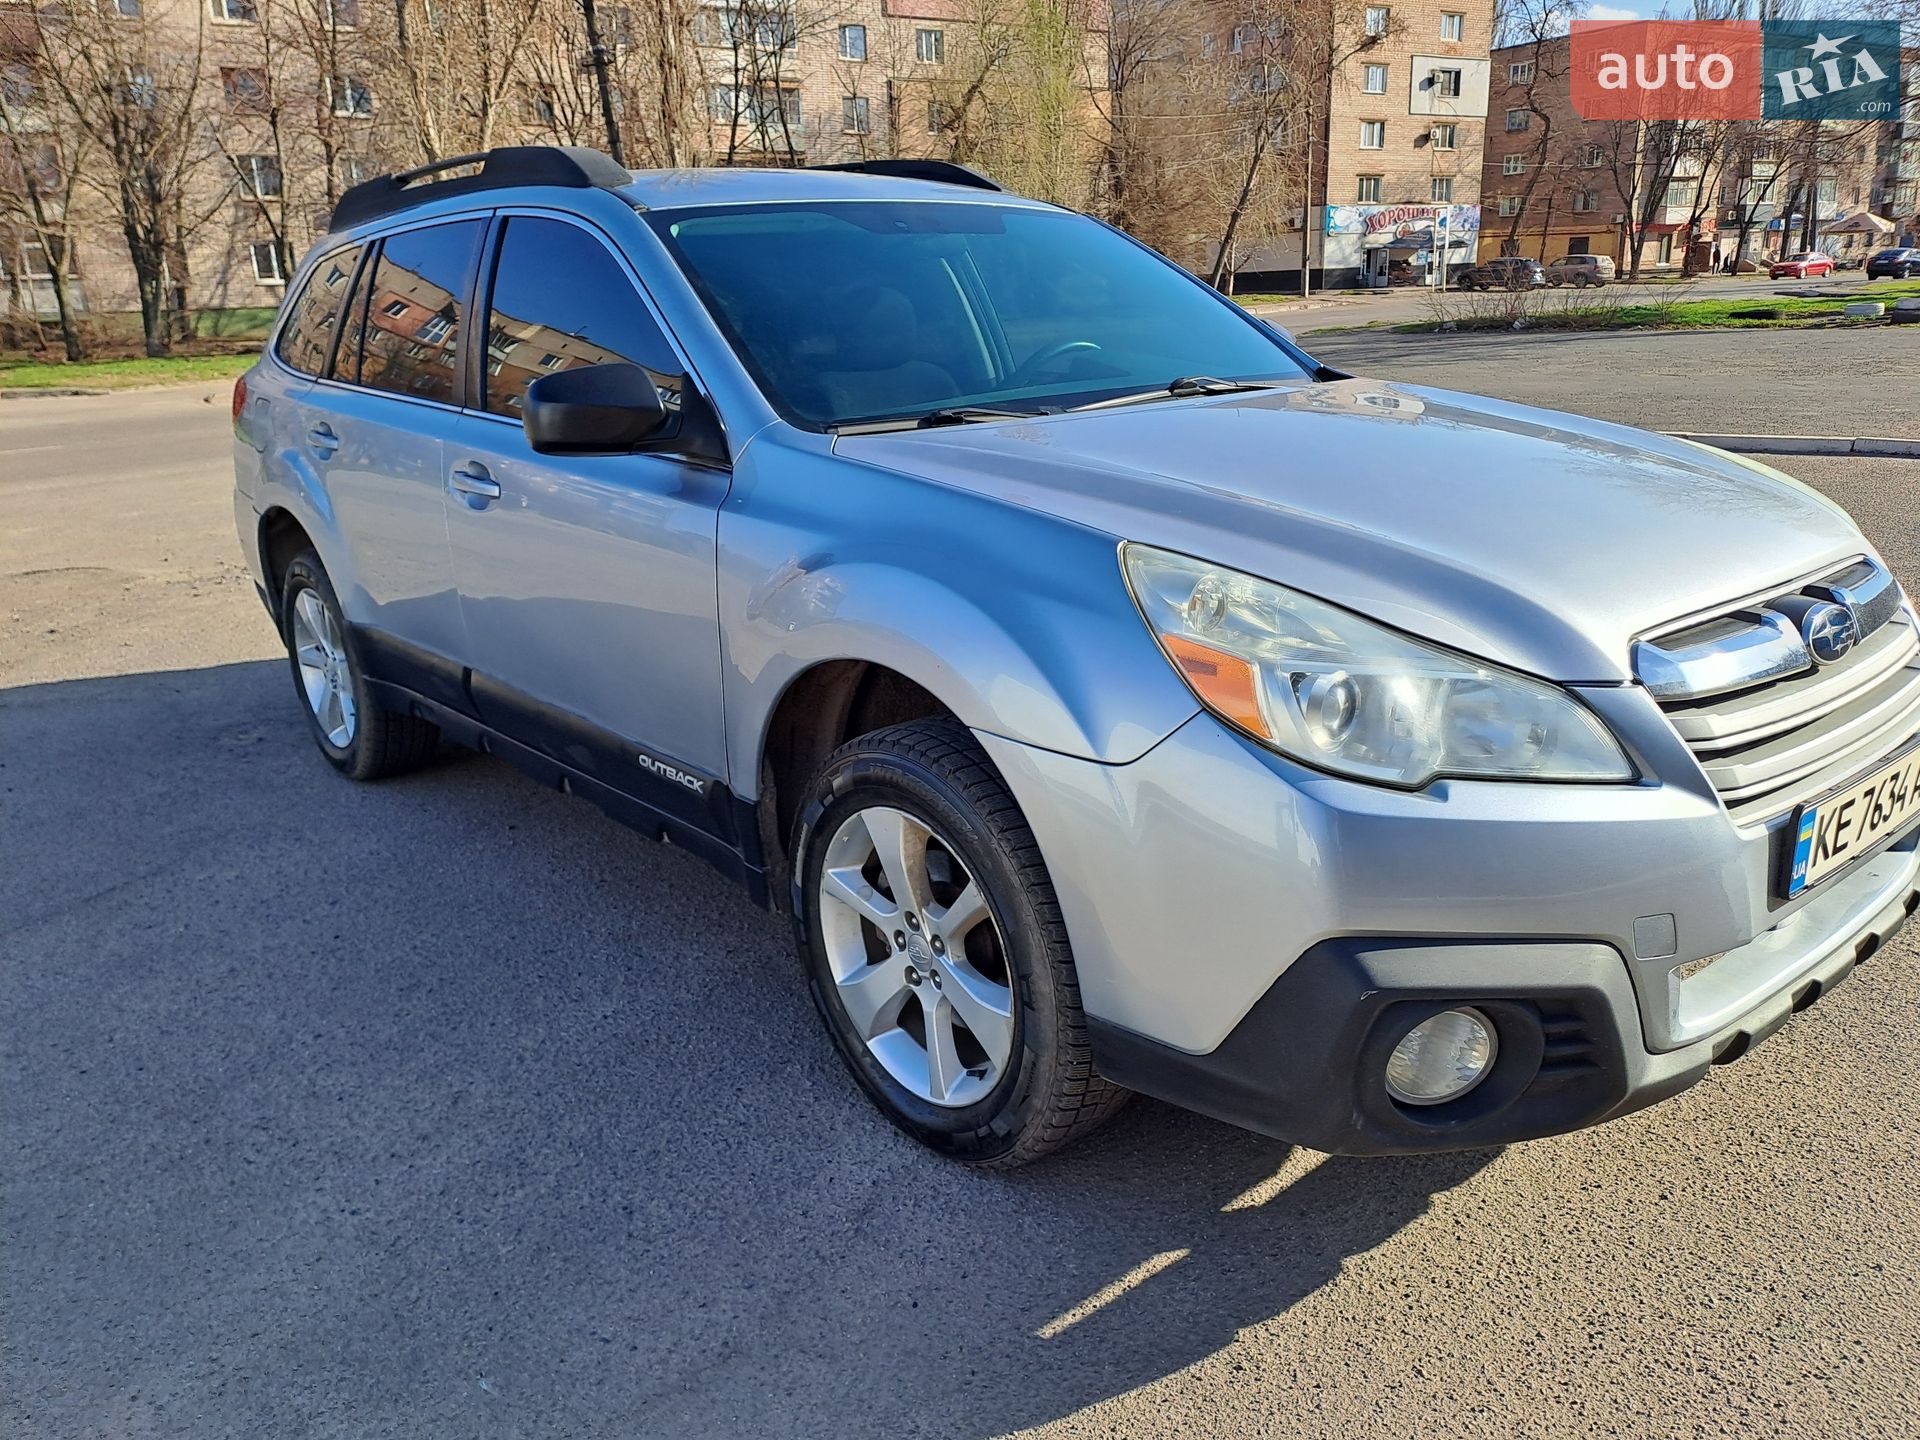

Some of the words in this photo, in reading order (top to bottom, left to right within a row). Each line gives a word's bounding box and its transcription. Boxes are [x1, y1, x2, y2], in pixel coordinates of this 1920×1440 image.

[639, 754, 704, 794] OUTBACK
[1811, 798, 1856, 869] KE
[1856, 763, 1912, 842] 7634
[1792, 859, 1806, 879] UA
